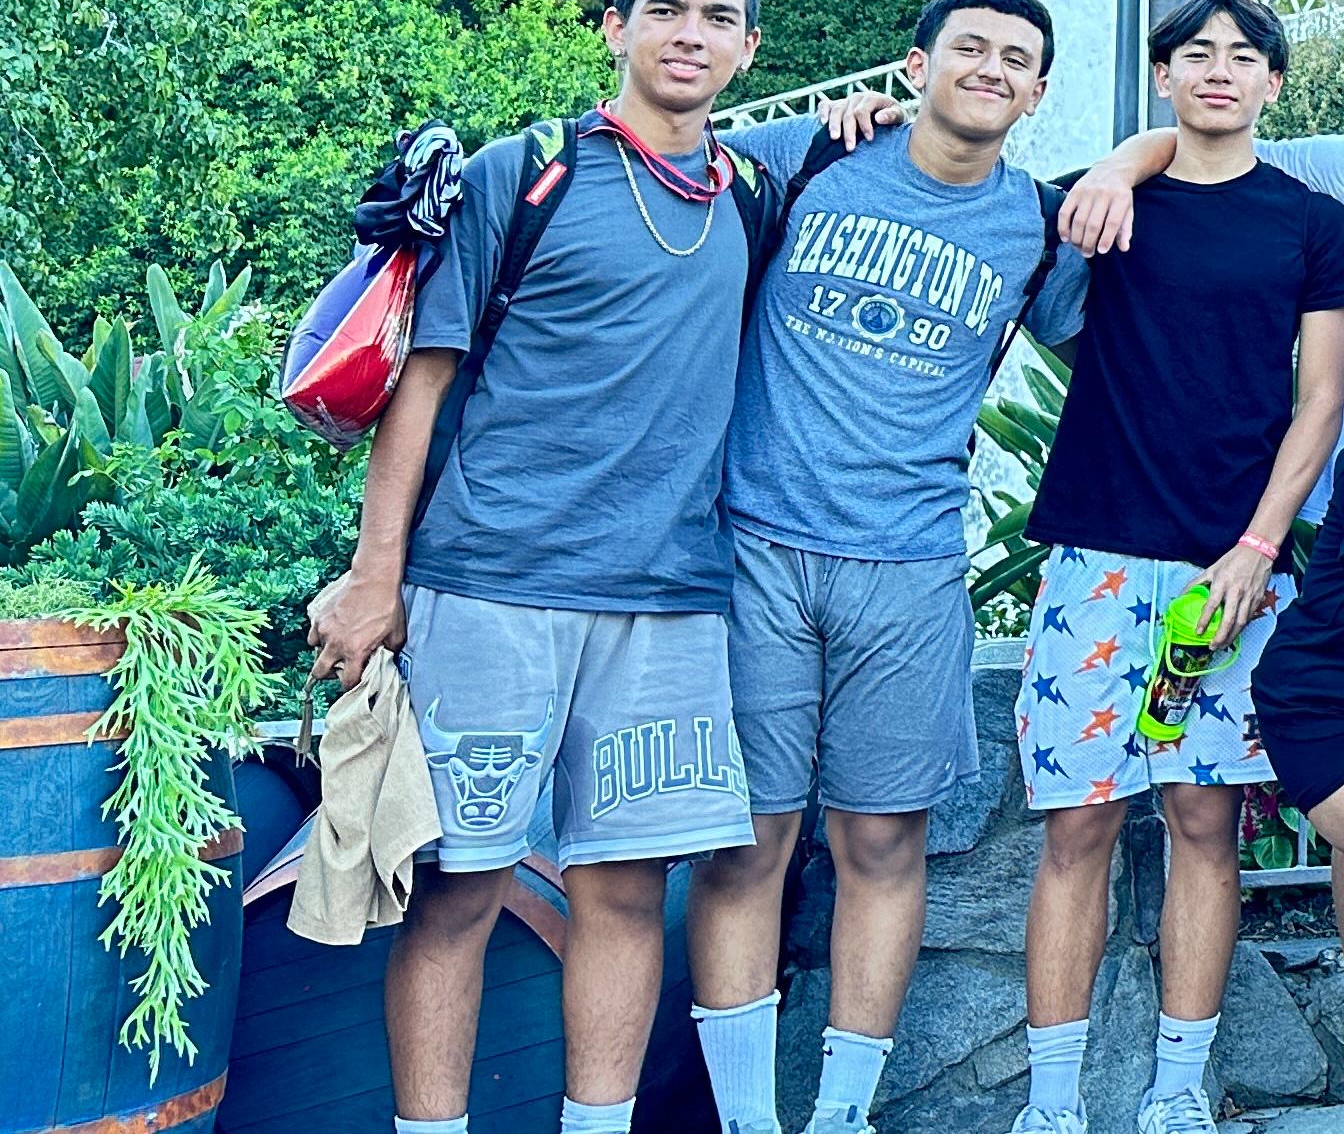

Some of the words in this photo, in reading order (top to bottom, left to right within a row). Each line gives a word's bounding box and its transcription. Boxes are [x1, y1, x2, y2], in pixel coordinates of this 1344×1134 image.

[786, 211, 977, 317] WASHINGTON
[965, 261, 1004, 337] DC
[785, 314, 811, 336] THE
[815, 327, 885, 360] NATION'S
[889, 352, 945, 378] CAPITAL
[808, 284, 847, 318] 17
[908, 317, 951, 351] 90
